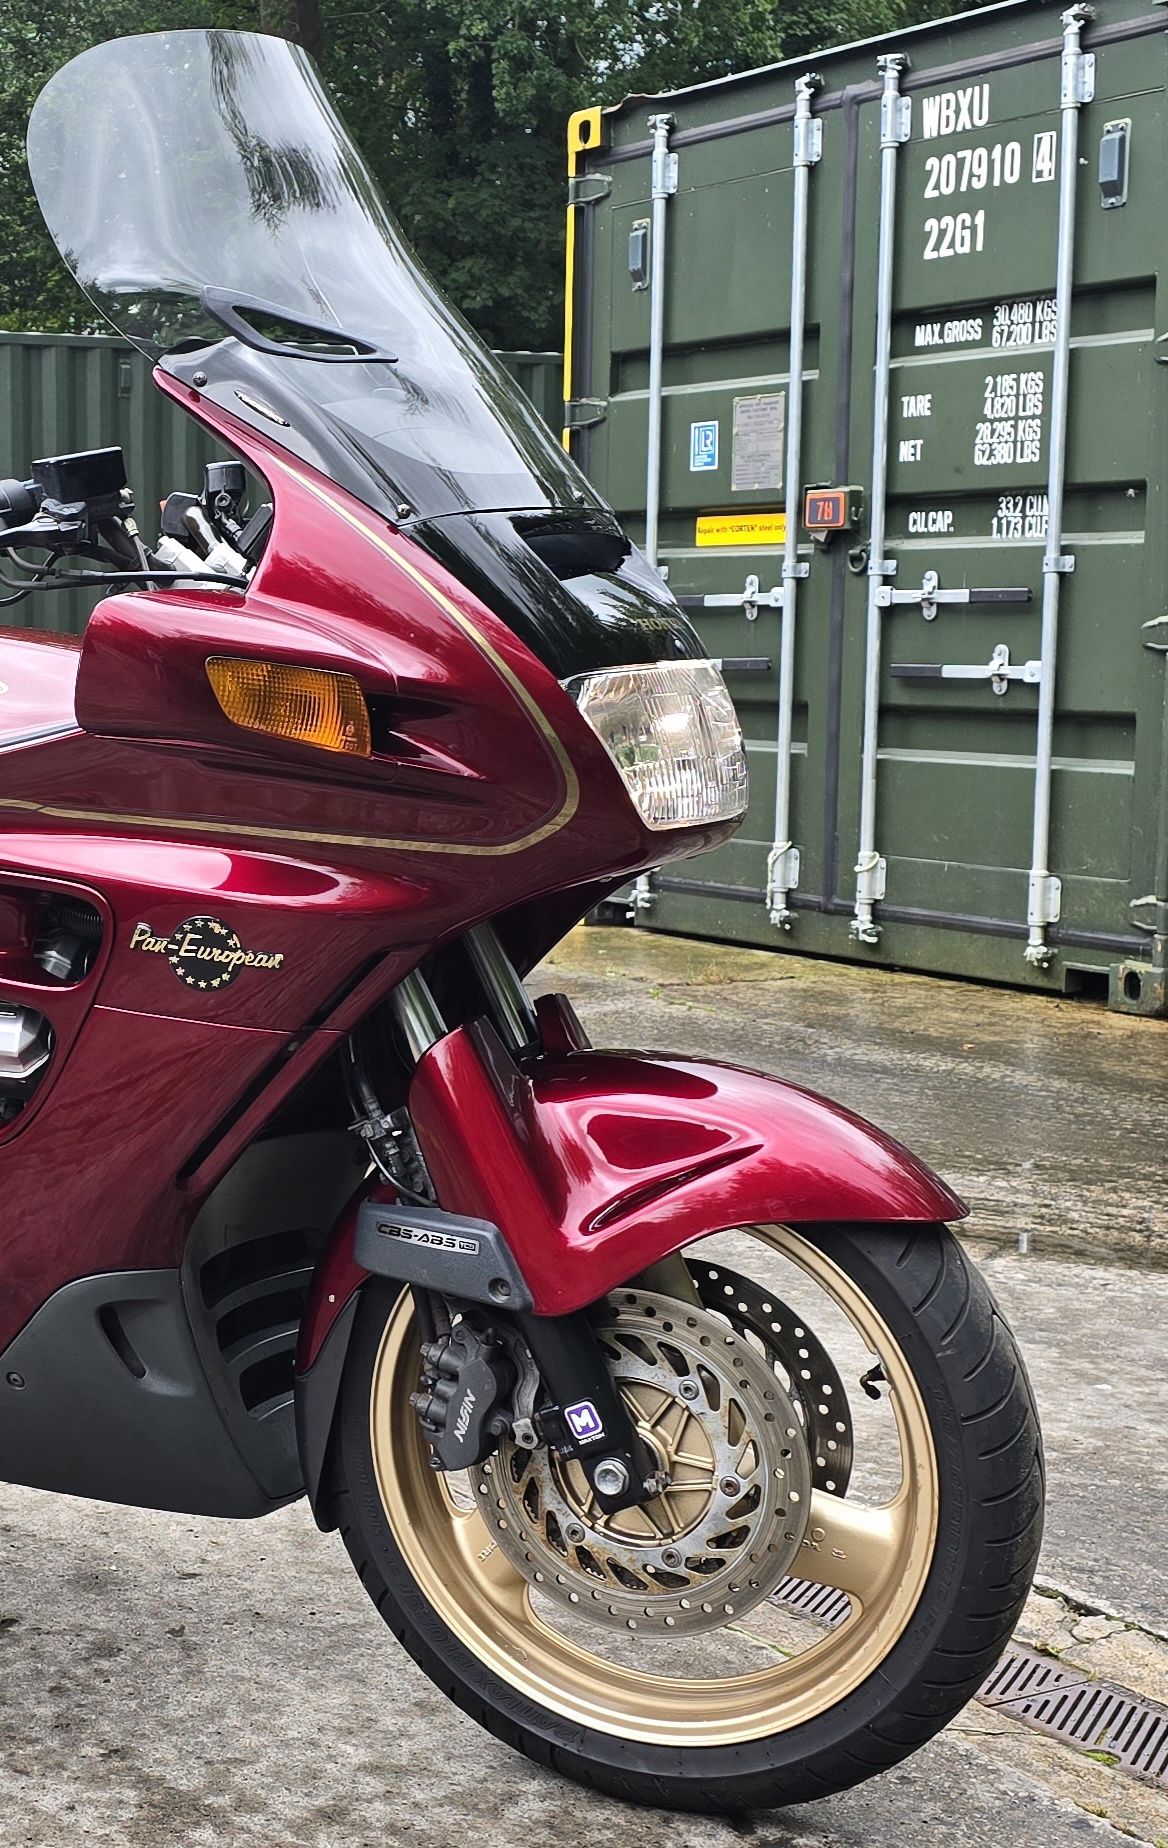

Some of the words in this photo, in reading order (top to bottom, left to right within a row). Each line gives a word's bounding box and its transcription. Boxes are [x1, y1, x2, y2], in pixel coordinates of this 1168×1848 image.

[922, 84, 990, 139] WBXU
[923, 141, 1022, 199] 207910
[1035, 134, 1053, 179] 4
[923, 209, 985, 260] 22G1
[1035, 299, 1057, 322] KGS
[1034, 320, 1057, 344] LBS
[1019, 371, 1044, 394] KGS
[901, 394, 932, 418] TARE
[1018, 393, 1043, 416] LBS
[1017, 418, 1042, 442] KGS
[899, 440, 924, 462] NET
[1016, 440, 1041, 463] LBS
[129, 922, 285, 972] Pan-European
[377, 1223, 457, 1249] CBS-ABS
[570, 1408, 597, 1434] M
[469, 1668, 580, 1745] BATTLAX
